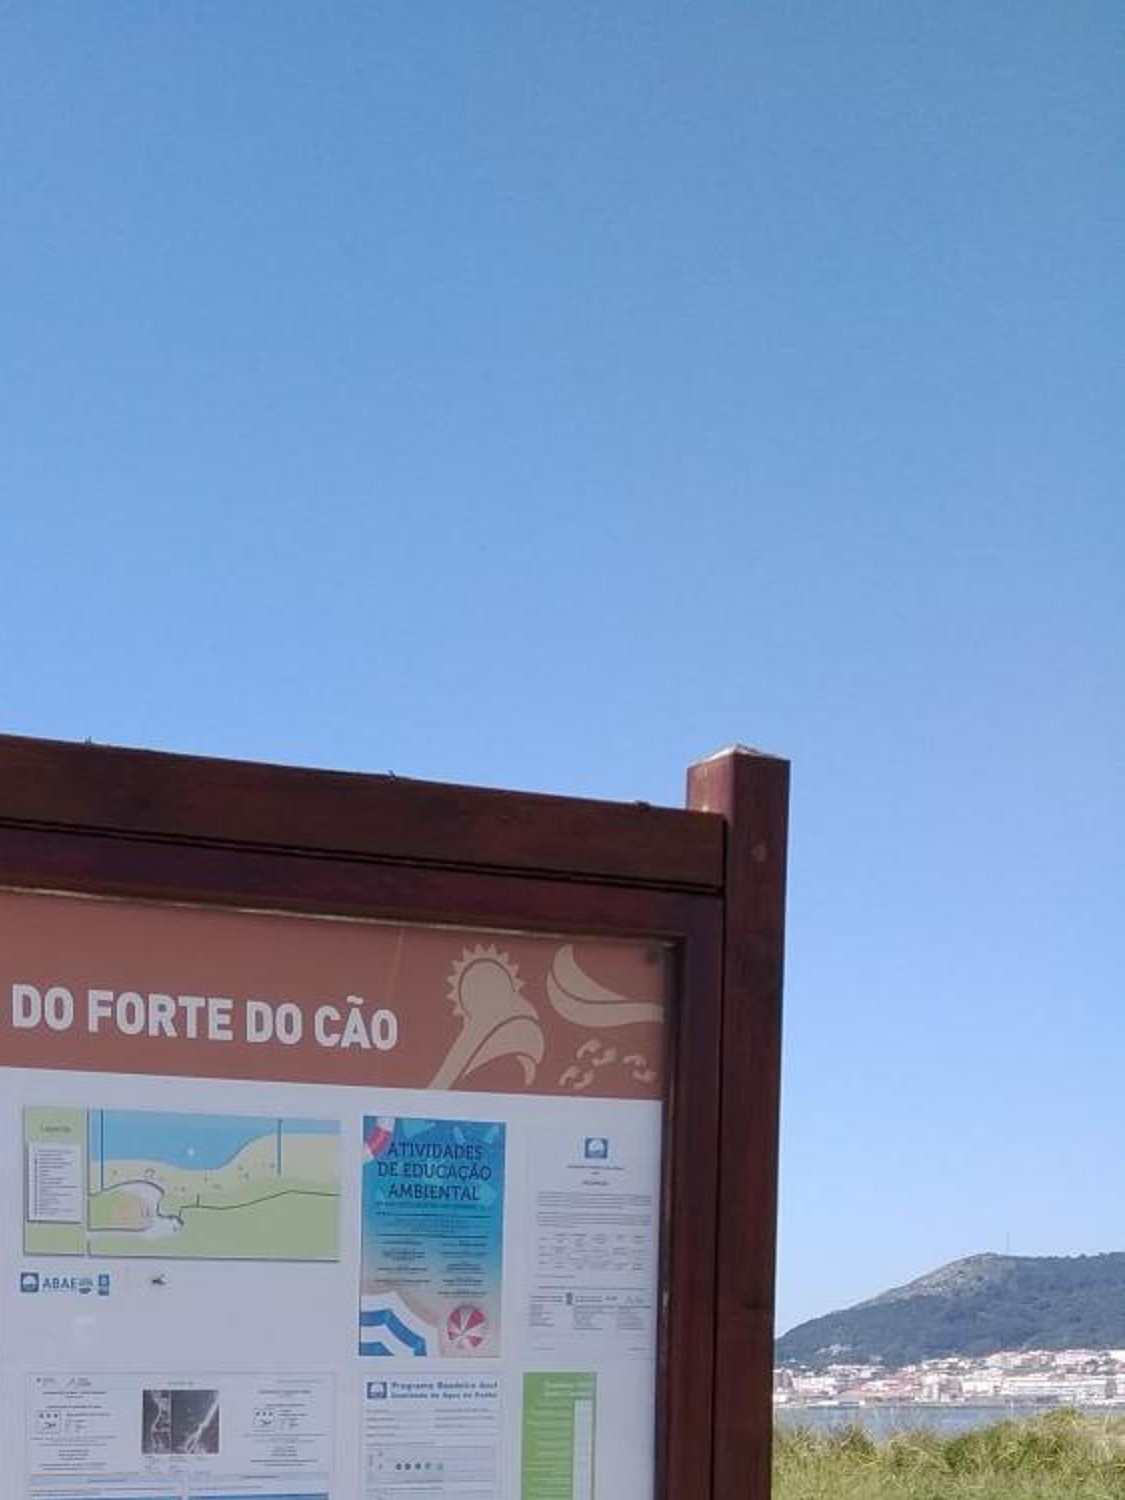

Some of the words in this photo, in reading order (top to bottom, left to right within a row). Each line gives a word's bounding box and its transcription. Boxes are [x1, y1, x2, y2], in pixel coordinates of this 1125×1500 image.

[11, 983, 74, 1031] DO
[87, 989, 234, 1041] FORTE
[245, 1000, 303, 1046] DO
[313, 995, 398, 1051] CÃO
[387, 1141, 483, 1161] ATIVIDADES
[378, 1161, 398, 1177] DE
[388, 1183, 480, 1201] AMBIENTAL
